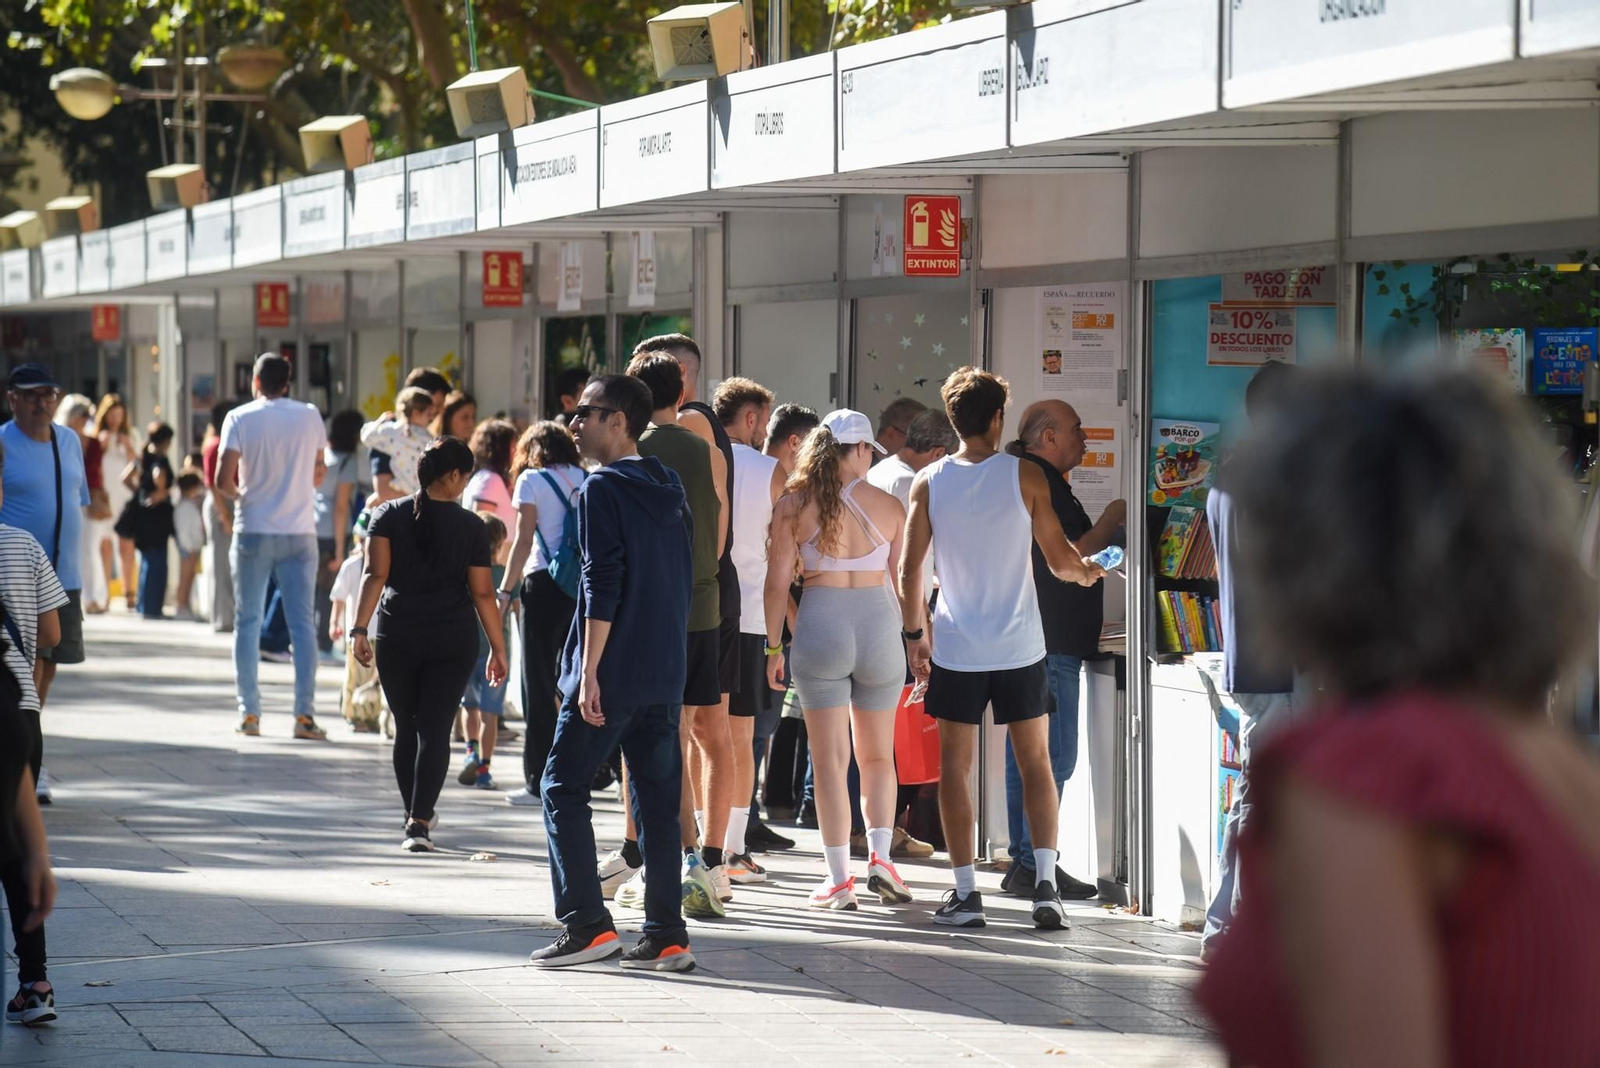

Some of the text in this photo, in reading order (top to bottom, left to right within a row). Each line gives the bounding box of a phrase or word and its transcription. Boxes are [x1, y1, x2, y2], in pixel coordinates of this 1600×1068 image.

[769, 112, 784, 135] LIBROS
[907, 259, 956, 269] EXTINTOR
[1244, 272, 1321, 285] PAGO CON
[1043, 290, 1068, 298] ESPAÑA
[1253, 286, 1312, 298] TARJETA
[1073, 314, 1082, 322] 23
[1231, 311, 1274, 330] 10%
[1210, 333, 1294, 346] DESCUENTO
[1171, 428, 1200, 438] BARCO
